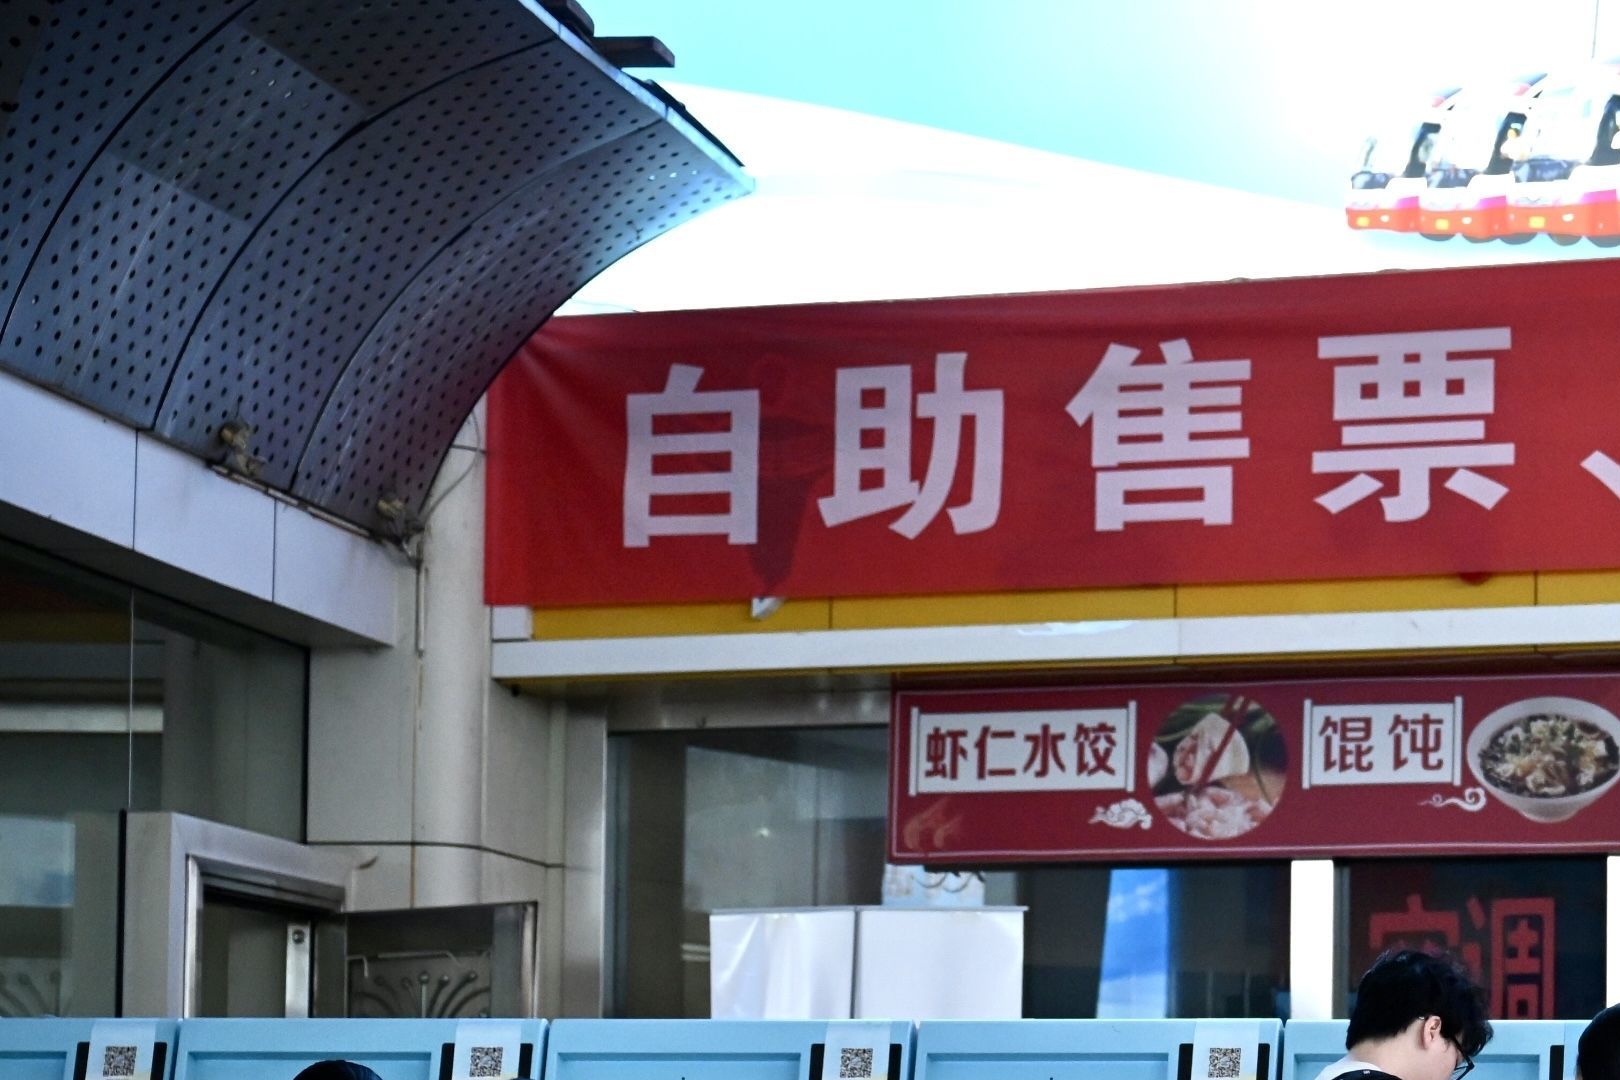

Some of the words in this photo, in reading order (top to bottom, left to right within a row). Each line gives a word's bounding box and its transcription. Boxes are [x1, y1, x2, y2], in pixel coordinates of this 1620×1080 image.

[925, 721, 1117, 780] 虾仁水饺
[1318, 713, 1444, 772] 馄饨
